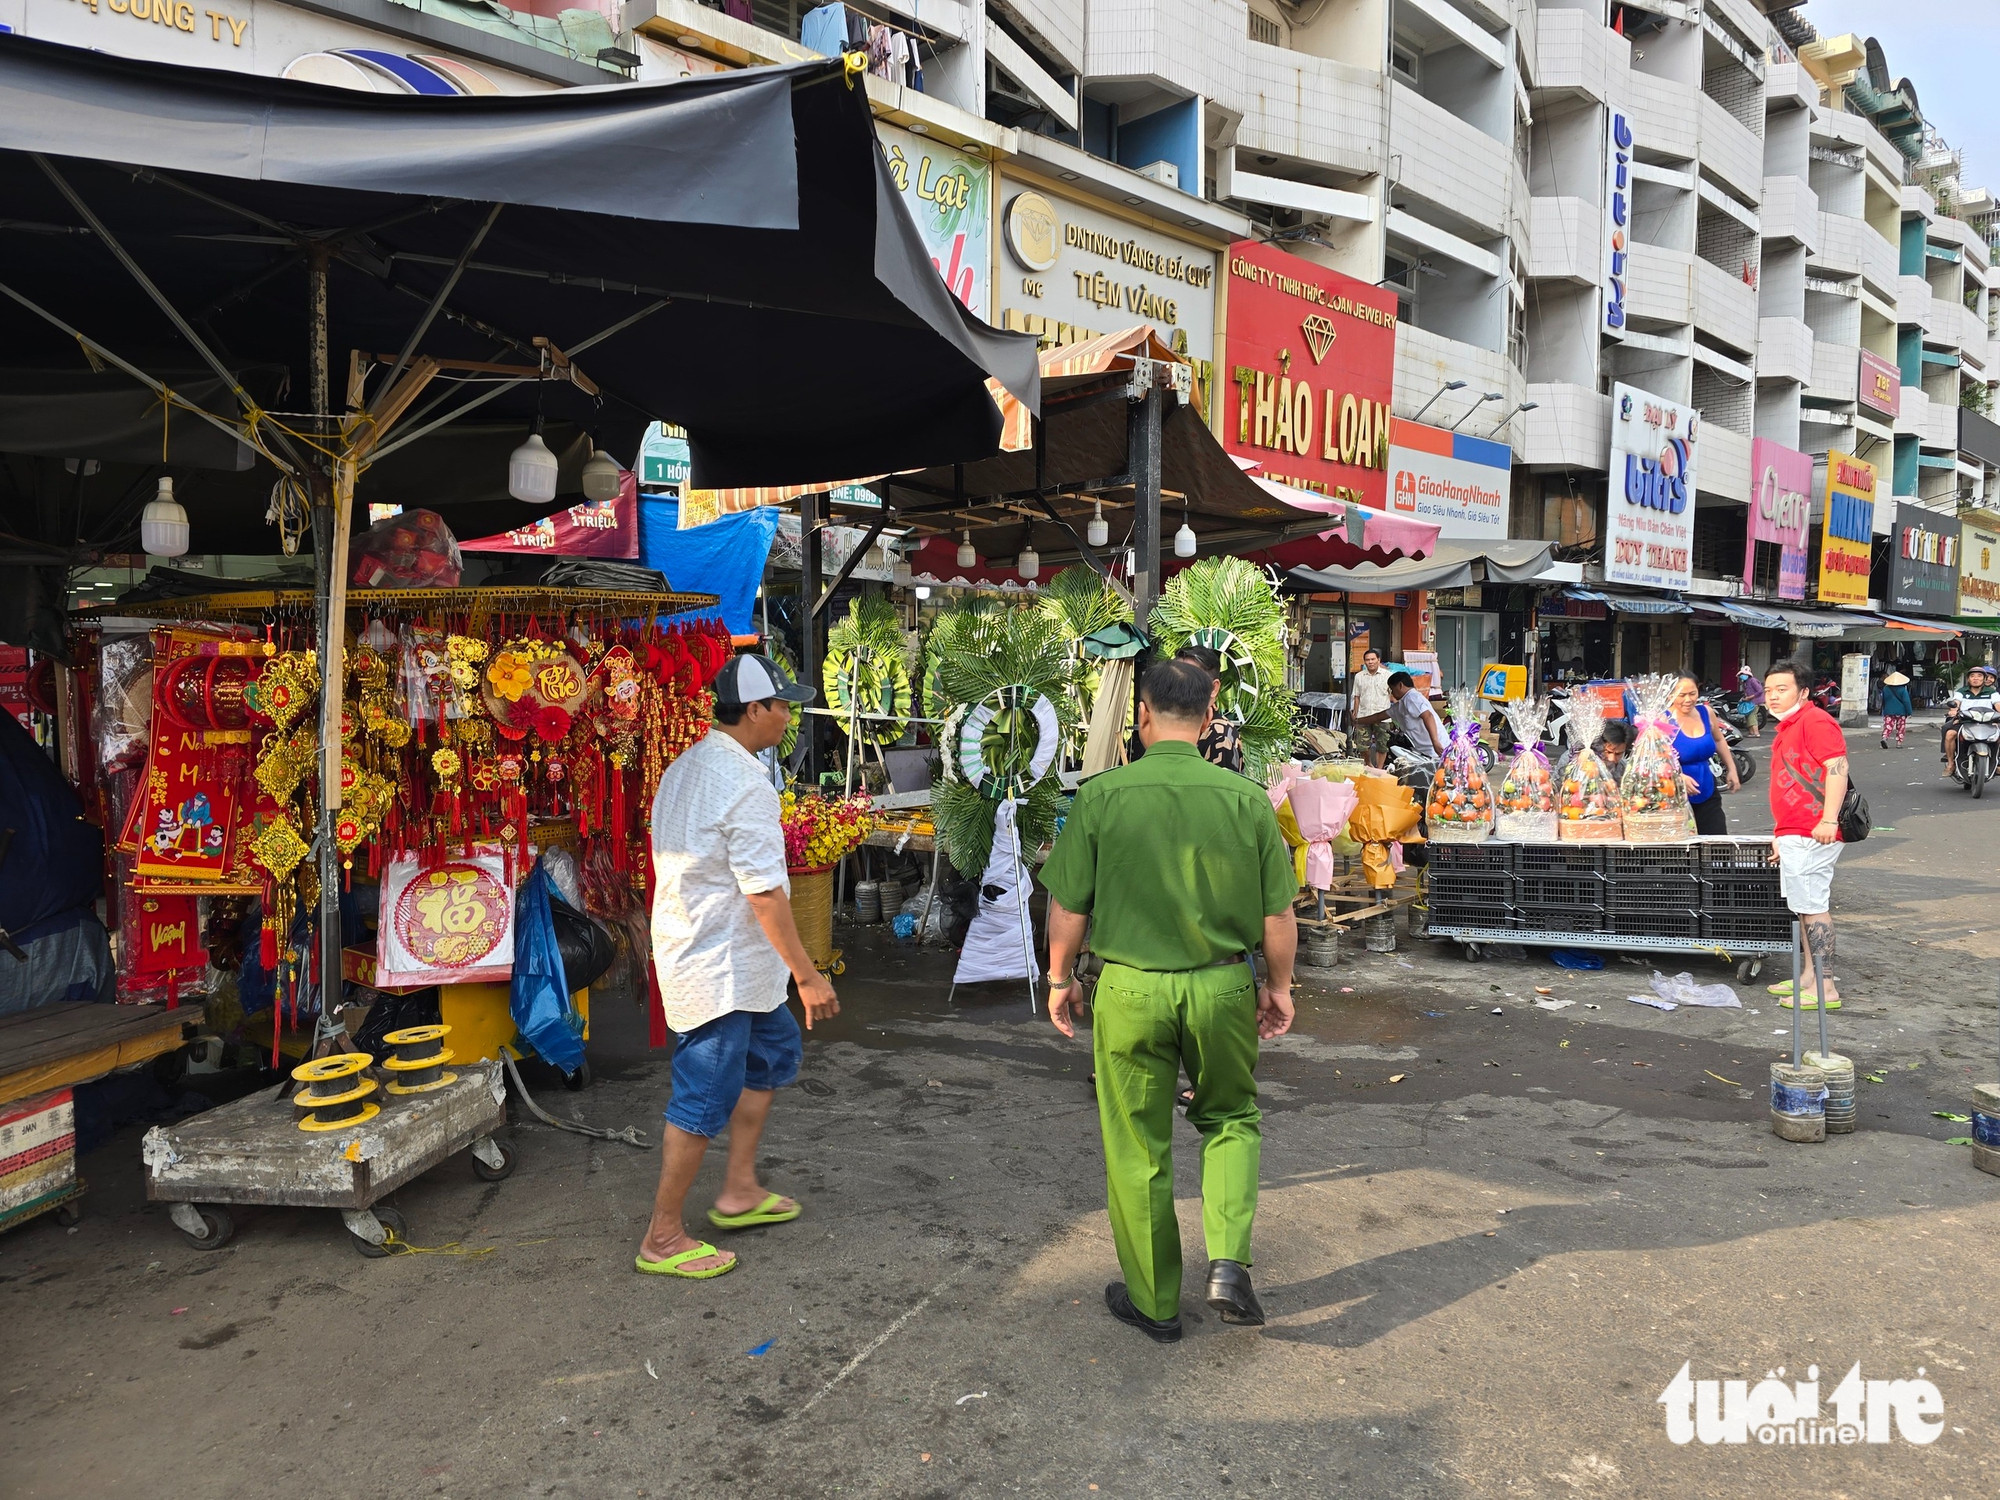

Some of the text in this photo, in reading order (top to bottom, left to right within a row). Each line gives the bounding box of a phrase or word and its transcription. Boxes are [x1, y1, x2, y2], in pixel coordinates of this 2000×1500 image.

[206, 10, 247, 47] TY
[917, 156, 970, 215] Lạt
[1122, 239, 1155, 271] VÀNG
[1157, 255, 1165, 275] &
[1167, 255, 1185, 281] ĐÁ
[1186, 264, 1213, 289] QUÝ
[1231, 255, 1257, 281] CÔNG
[1257, 267, 1274, 287] TY
[1276, 273, 1300, 297] TNHH
[1022, 277, 1044, 298] MC
[1074, 270, 1178, 325] TIỆM VÀNG
[1232, 348, 1313, 456] THẢO
[1322, 388, 1391, 471] LOAN
[657, 463, 663, 478] 1
[1396, 491, 1414, 506] GHN
[1417, 502, 1432, 514] Giao
[1418, 475, 1501, 507] GiaoHangNhanh
[1761, 464, 1811, 550] Cherry
[1829, 491, 1874, 544] MINH
[1615, 538, 1688, 573] DUY THANH
